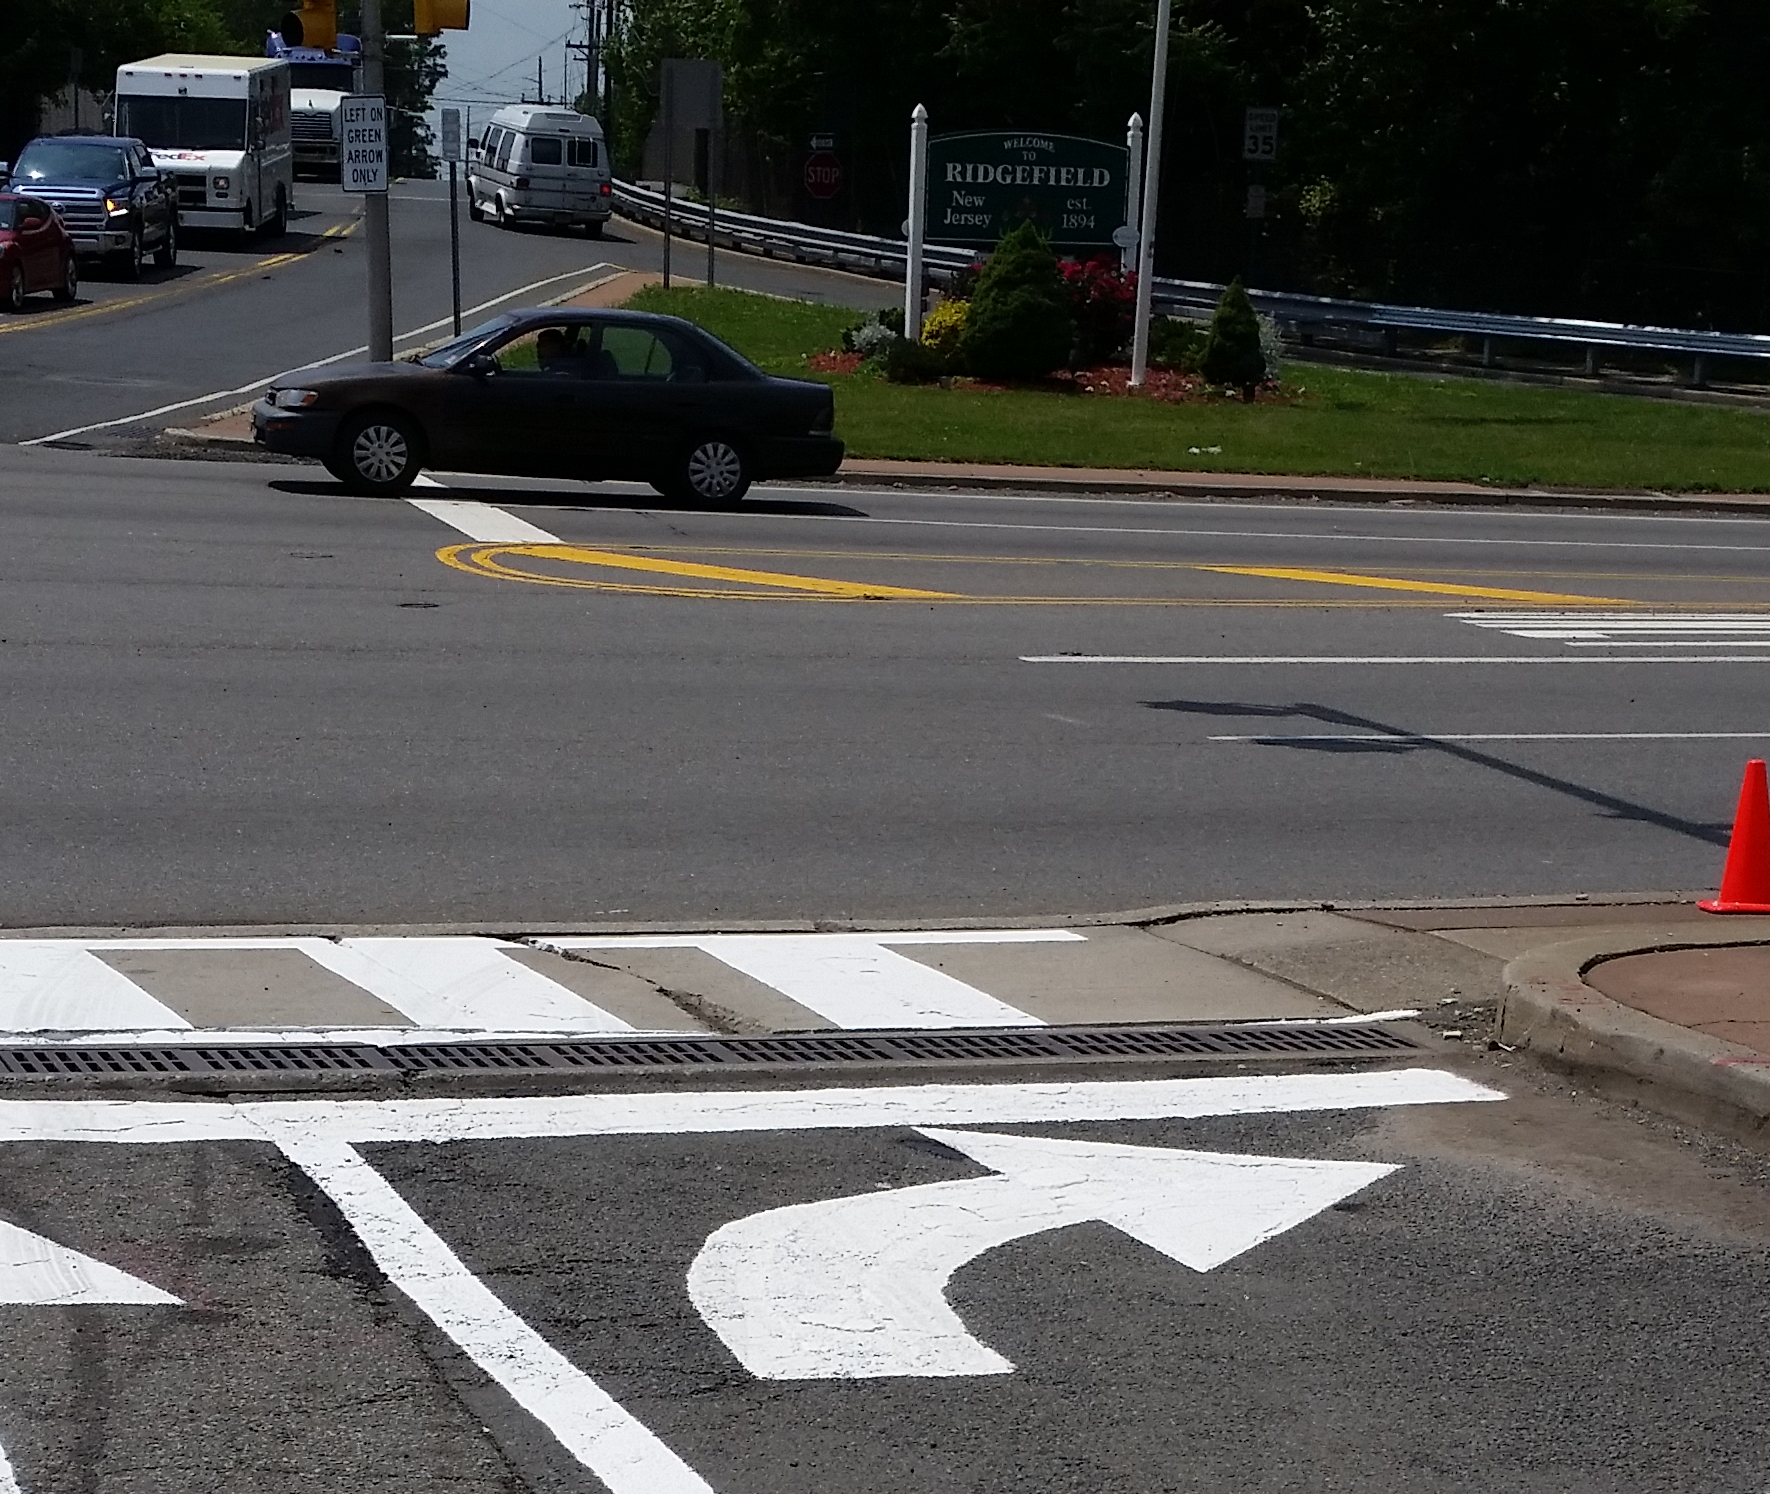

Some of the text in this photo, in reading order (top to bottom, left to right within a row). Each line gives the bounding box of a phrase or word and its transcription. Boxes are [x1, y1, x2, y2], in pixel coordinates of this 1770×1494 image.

[344, 107, 383, 123] LEFT ON
[347, 128, 382, 144] GREEN
[1003, 137, 1056, 152] WELCOME
[1247, 135, 1274, 154] 35
[346, 149, 383, 164] ARROW
[1023, 152, 1036, 161] TO
[351, 168, 379, 184] ONLY
[808, 166, 840, 183] STOP
[945, 162, 1111, 188] RIDGEFIELD
[951, 190, 986, 207] New
[1066, 197, 1092, 211] est.
[943, 207, 992, 228] Jersey
[1061, 213, 1096, 229] 1894
